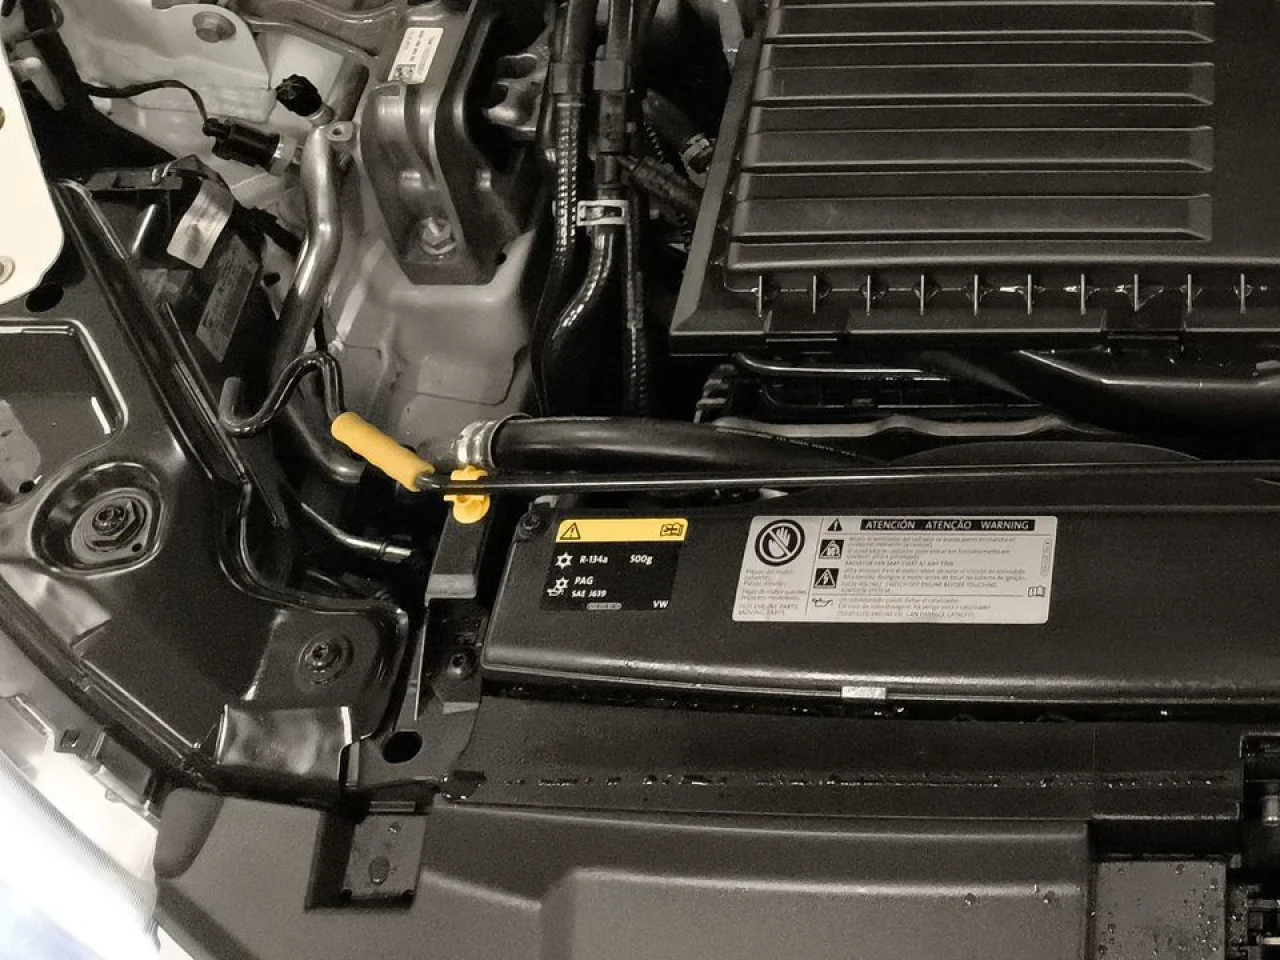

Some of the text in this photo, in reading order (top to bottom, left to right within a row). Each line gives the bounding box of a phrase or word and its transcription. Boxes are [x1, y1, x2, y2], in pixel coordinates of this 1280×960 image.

[865, 519, 1029, 531] ATENCIÓN ATENÇÃO WARNING
[579, 555, 609, 564] R-134a
[629, 554, 654, 565] 500g
[574, 576, 594, 585] PAG
[571, 589, 587, 598] SAE
[652, 600, 669, 609] VW
